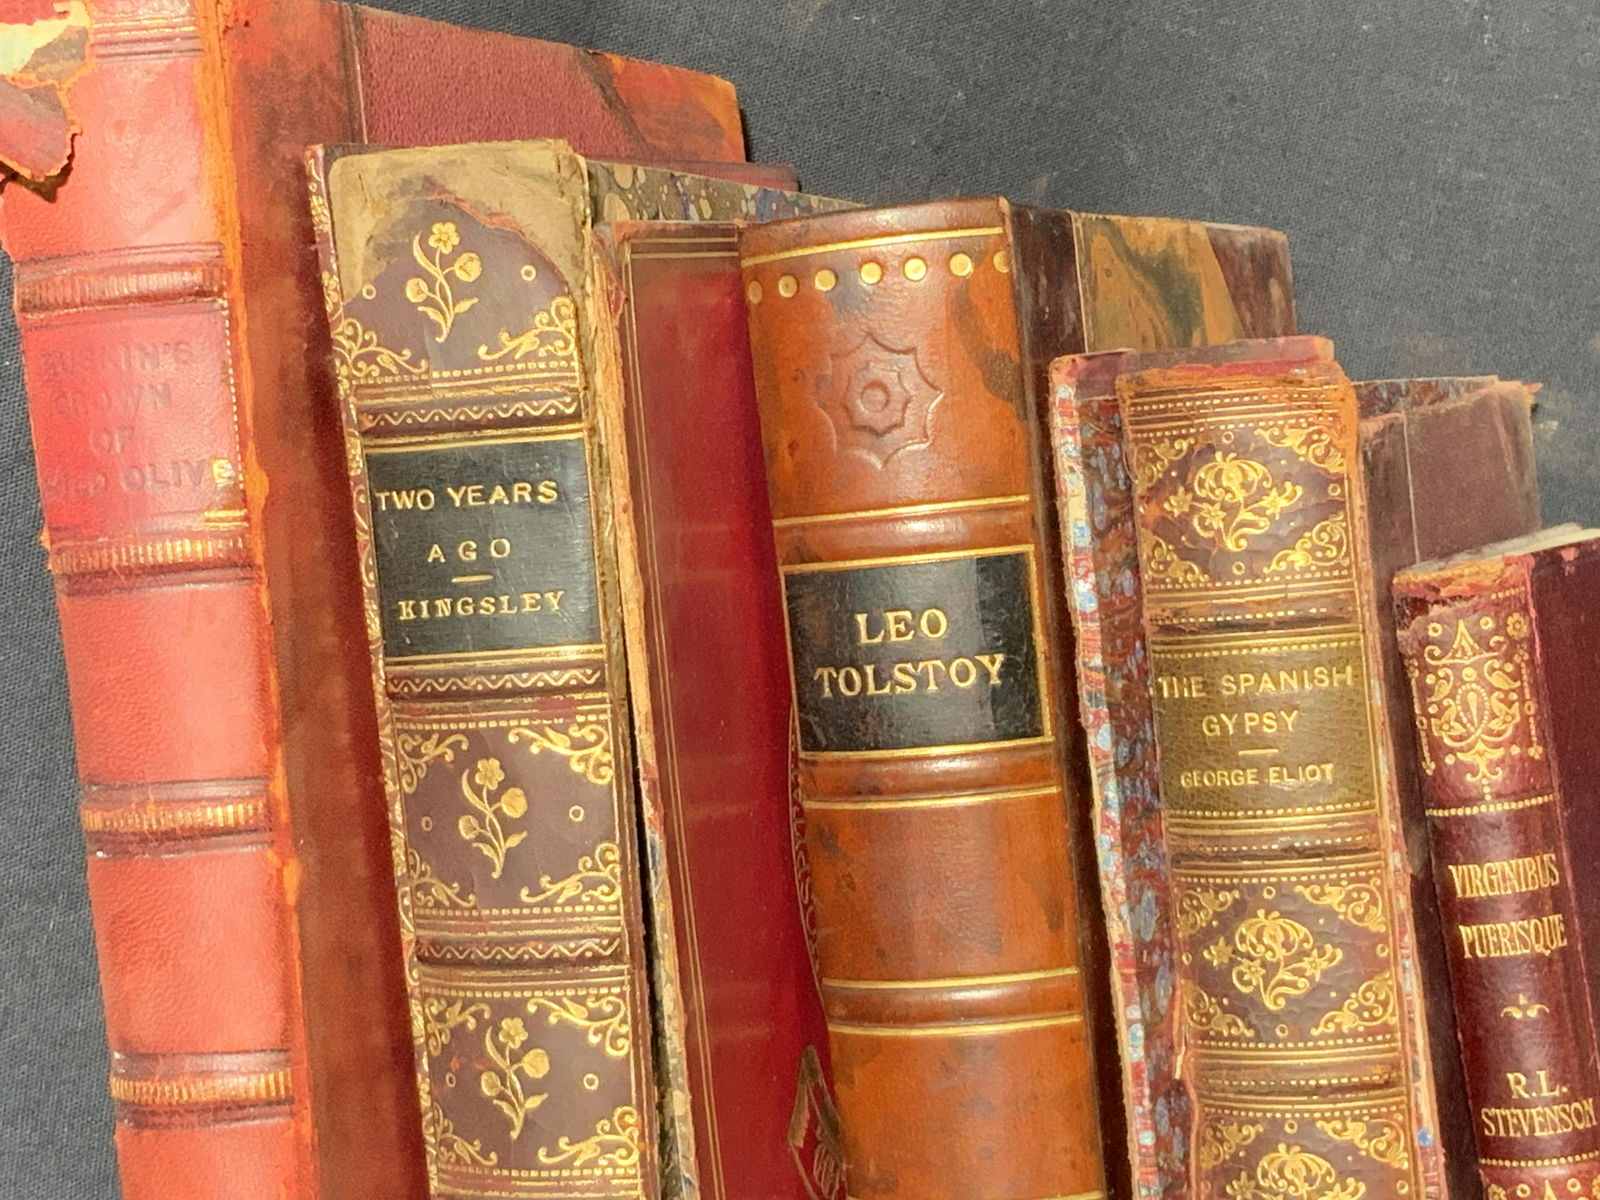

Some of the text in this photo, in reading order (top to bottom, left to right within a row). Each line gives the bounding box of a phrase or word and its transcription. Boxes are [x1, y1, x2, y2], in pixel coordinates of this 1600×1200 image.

[88, 425, 134, 455] OF
[120, 457, 235, 492] OLIVE
[375, 480, 558, 511] TWO YEARS
[427, 538, 511, 563] AGO
[398, 591, 565, 620] KINGSLEY
[854, 608, 947, 643] LEO
[814, 653, 1005, 698] TOLSTOY
[1158, 665, 1353, 699] THE SPANISH
[1202, 710, 1298, 736] GYPSY
[1180, 763, 1334, 788] GEORGE ELIOT
[1448, 853, 1560, 898] VIRGINIBUS
[1458, 914, 1568, 959] PUERISQUE
[1481, 1098, 1597, 1138] STEVENSON
